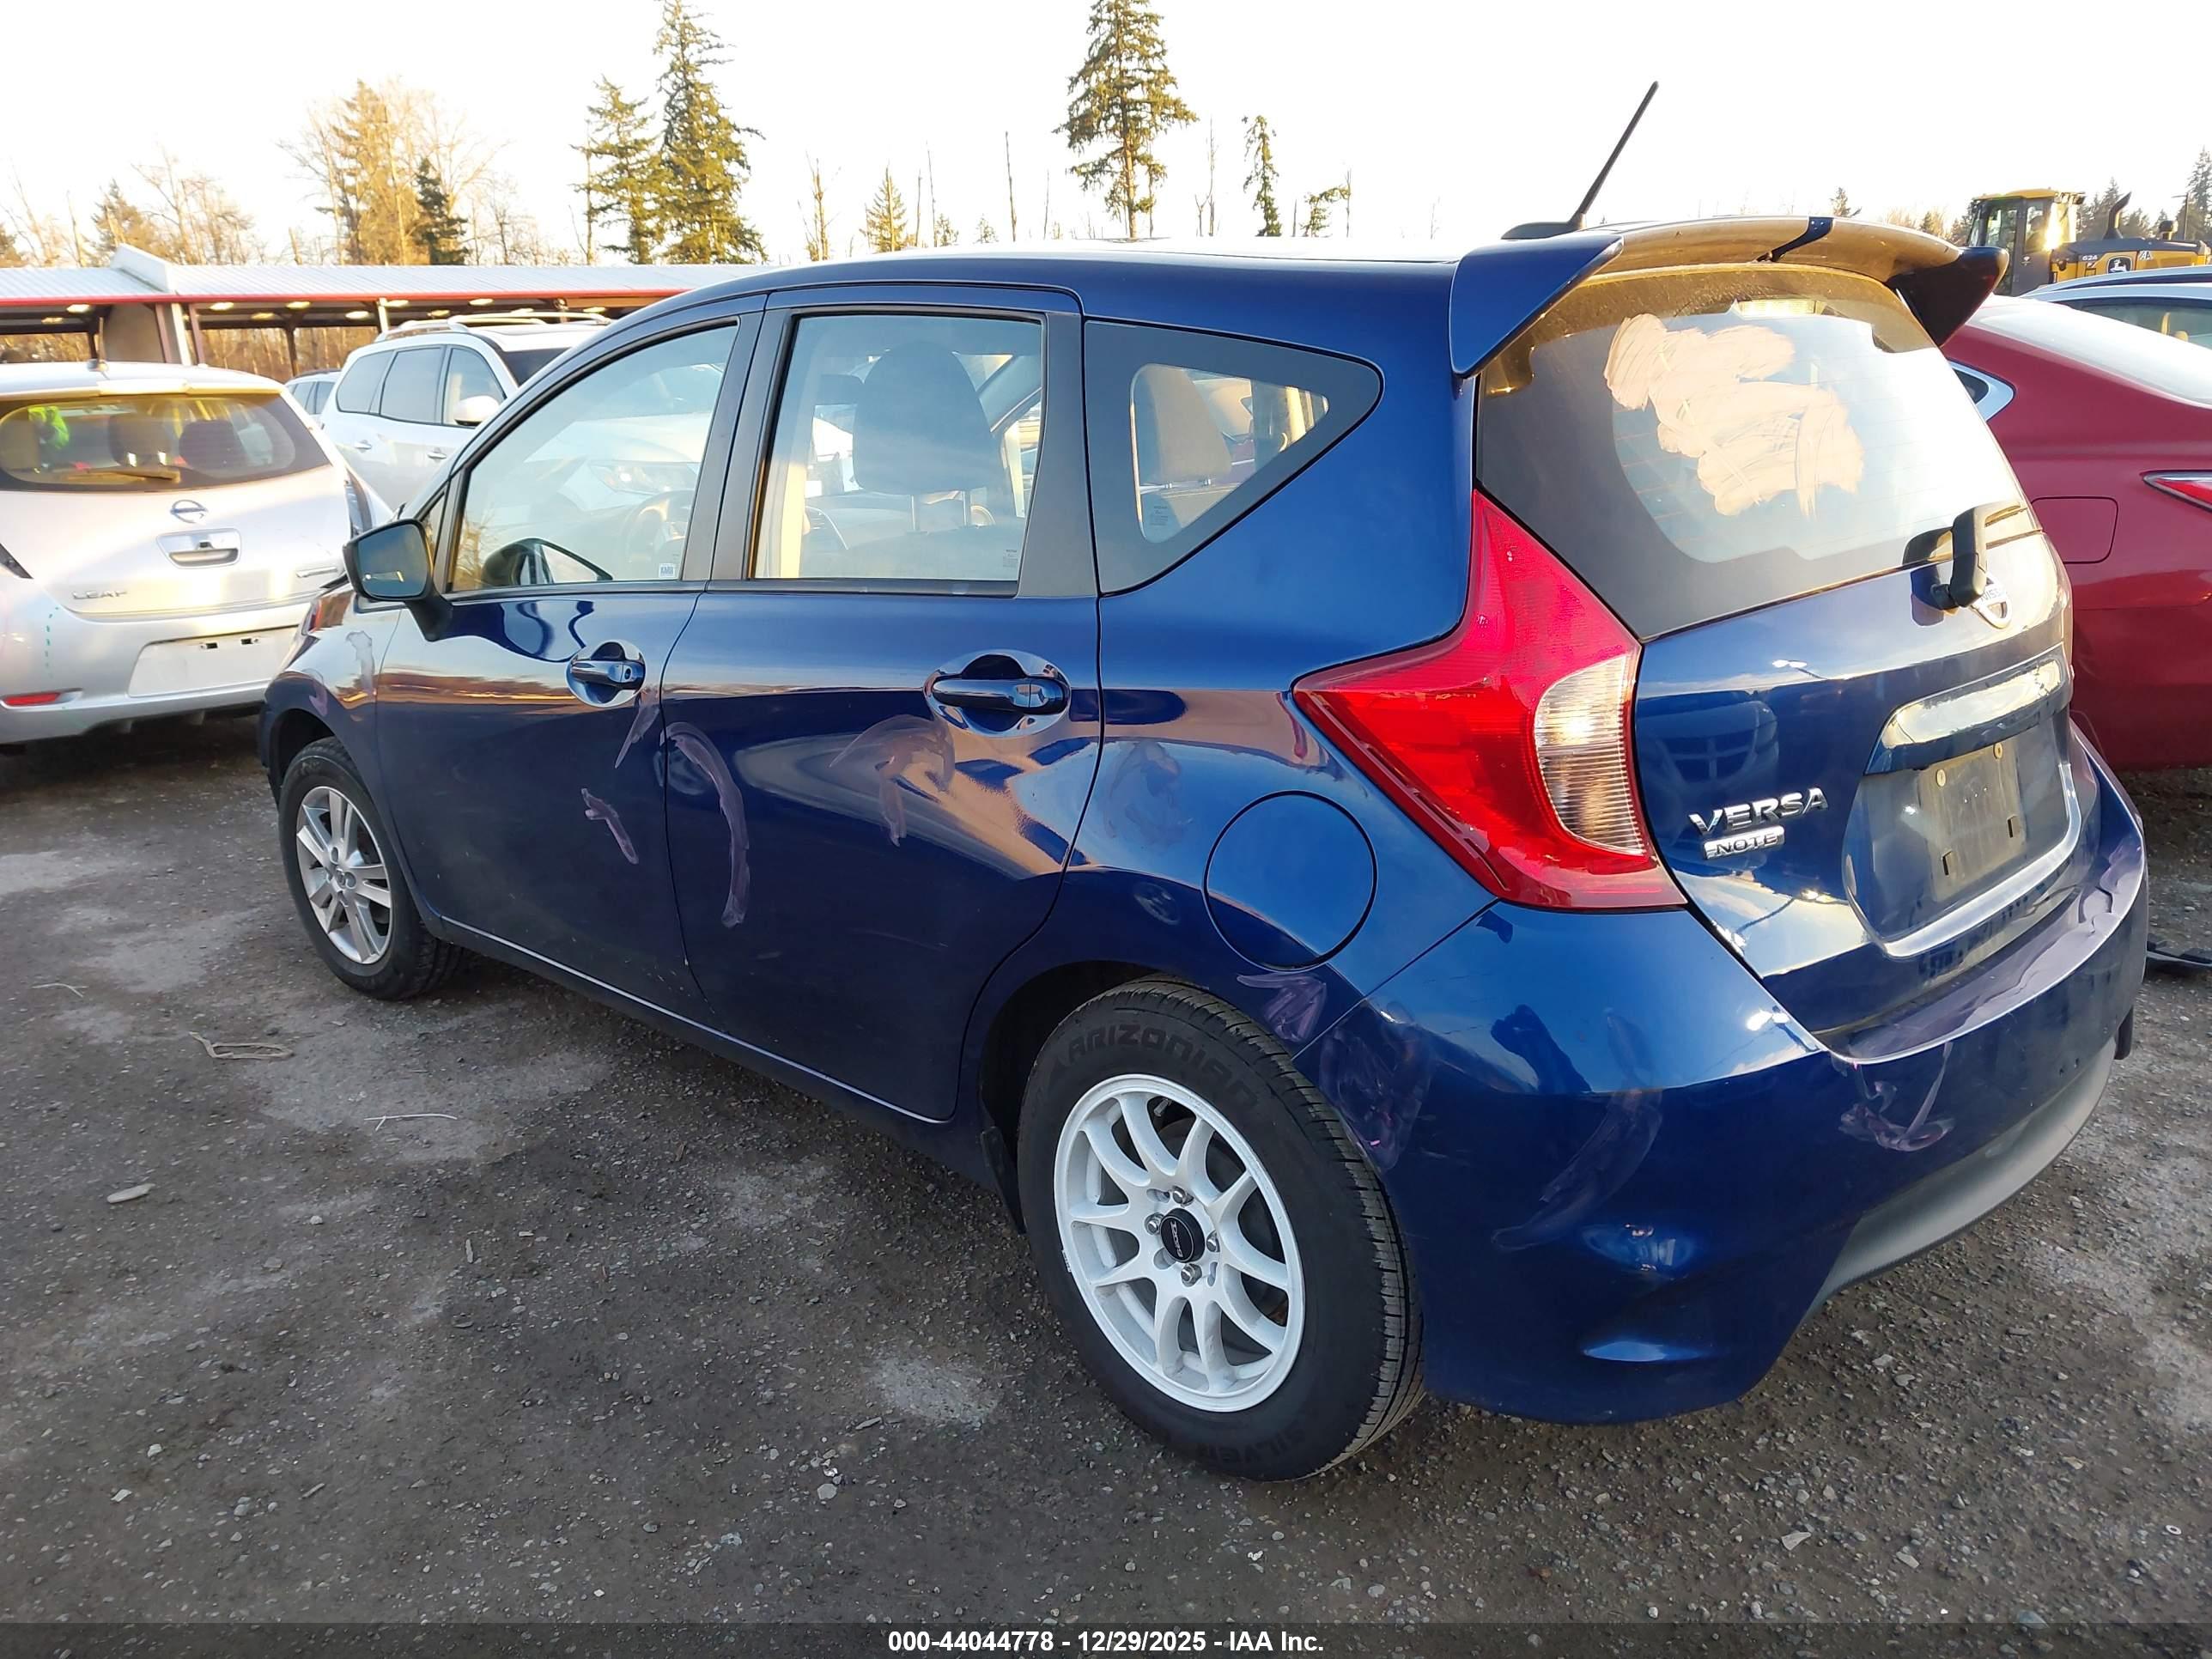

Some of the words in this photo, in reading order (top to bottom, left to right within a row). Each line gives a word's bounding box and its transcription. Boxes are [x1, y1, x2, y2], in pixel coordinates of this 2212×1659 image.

[1688, 787, 1829, 836] VERSA
[1717, 833, 1778, 855] NOTE
[1068, 1024, 1258, 1108] ARIZONIAN
